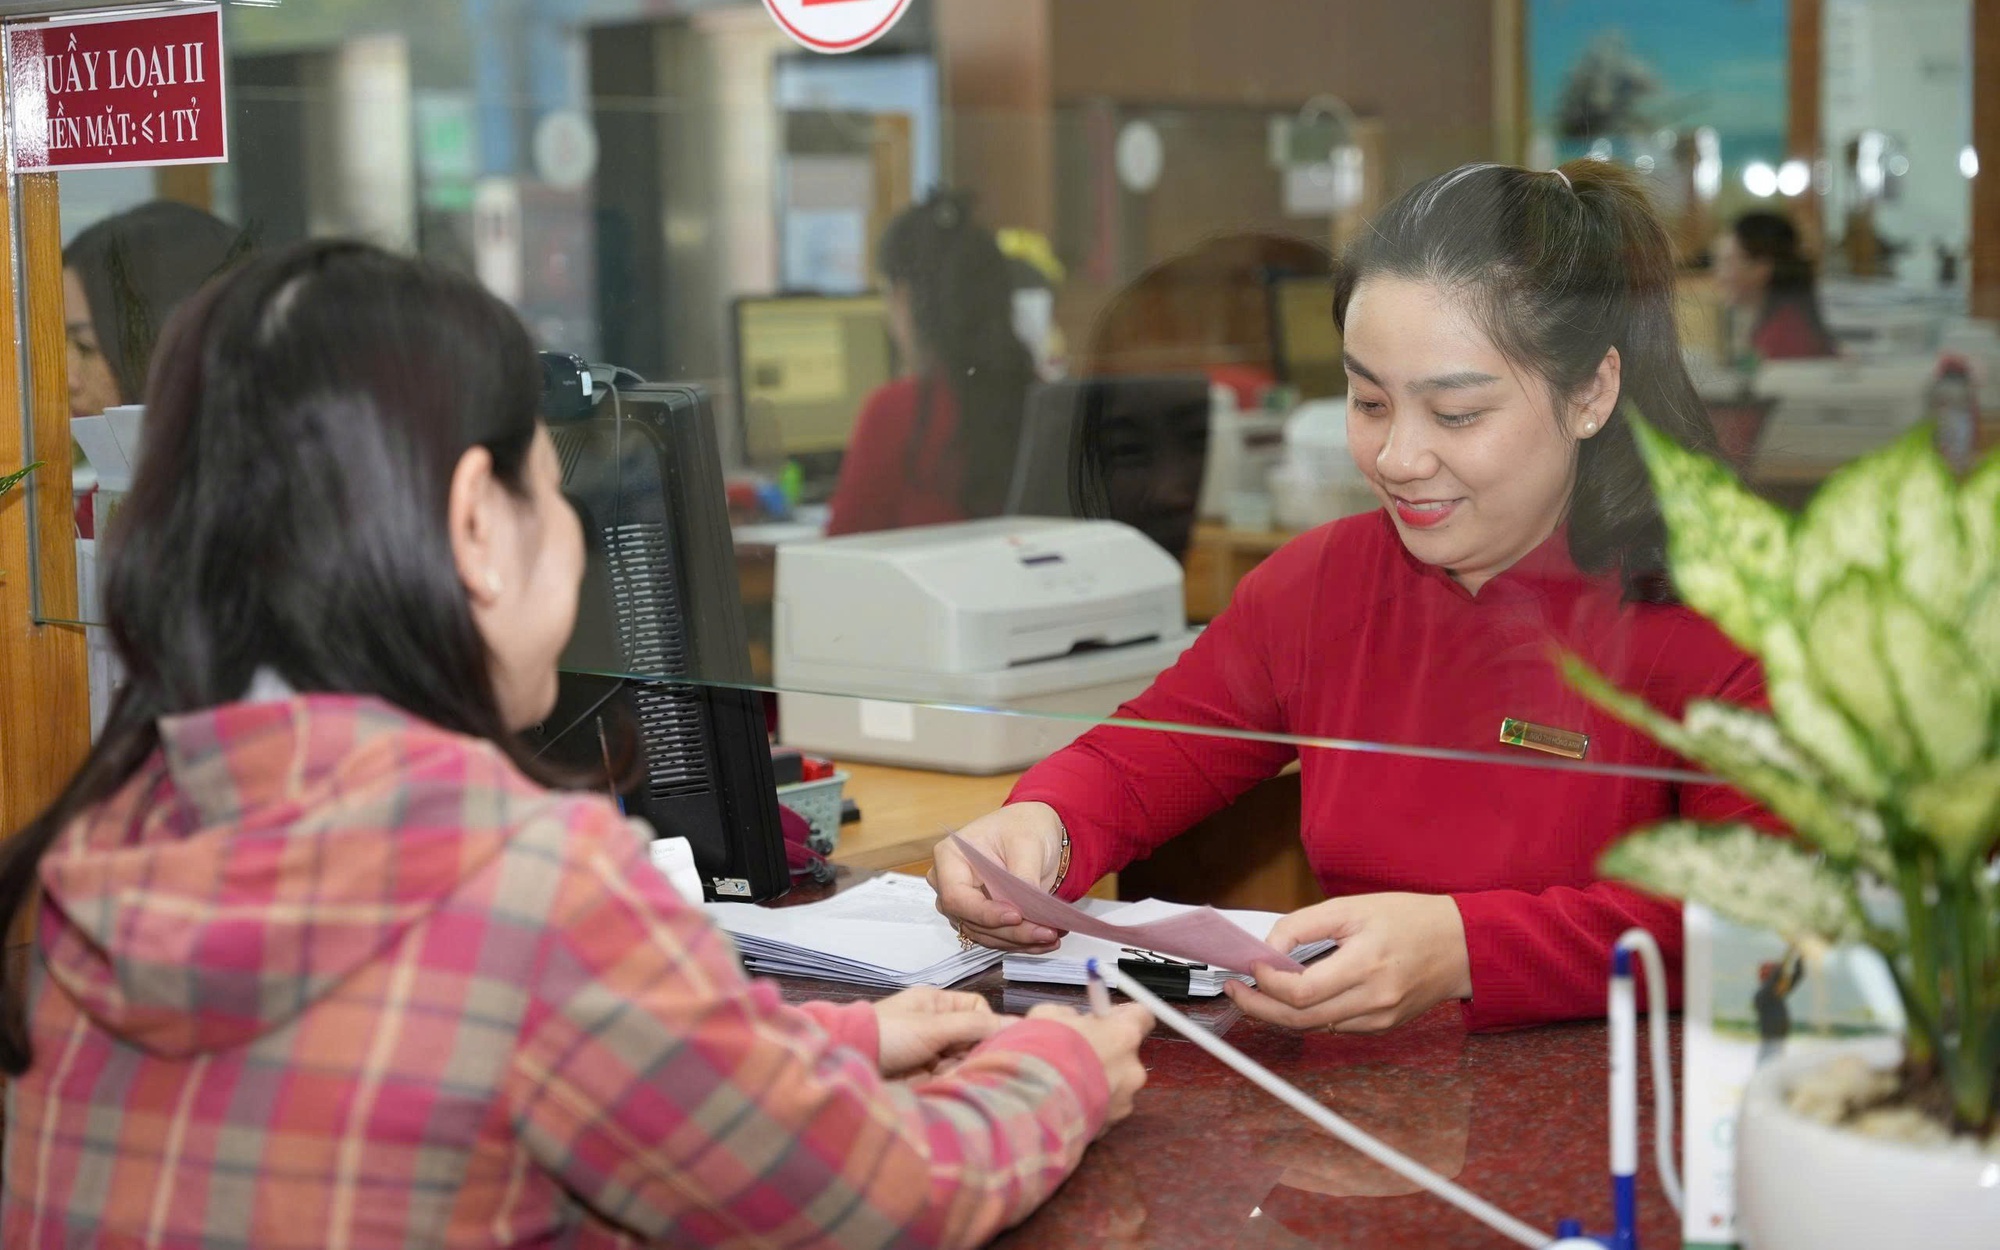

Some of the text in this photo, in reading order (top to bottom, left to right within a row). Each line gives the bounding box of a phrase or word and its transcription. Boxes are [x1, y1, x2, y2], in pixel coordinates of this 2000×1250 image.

[45, 32, 206, 98] UẦY LOẠI II
[47, 101, 81, 149] IỀN
[172, 96, 201, 142] TỶ
